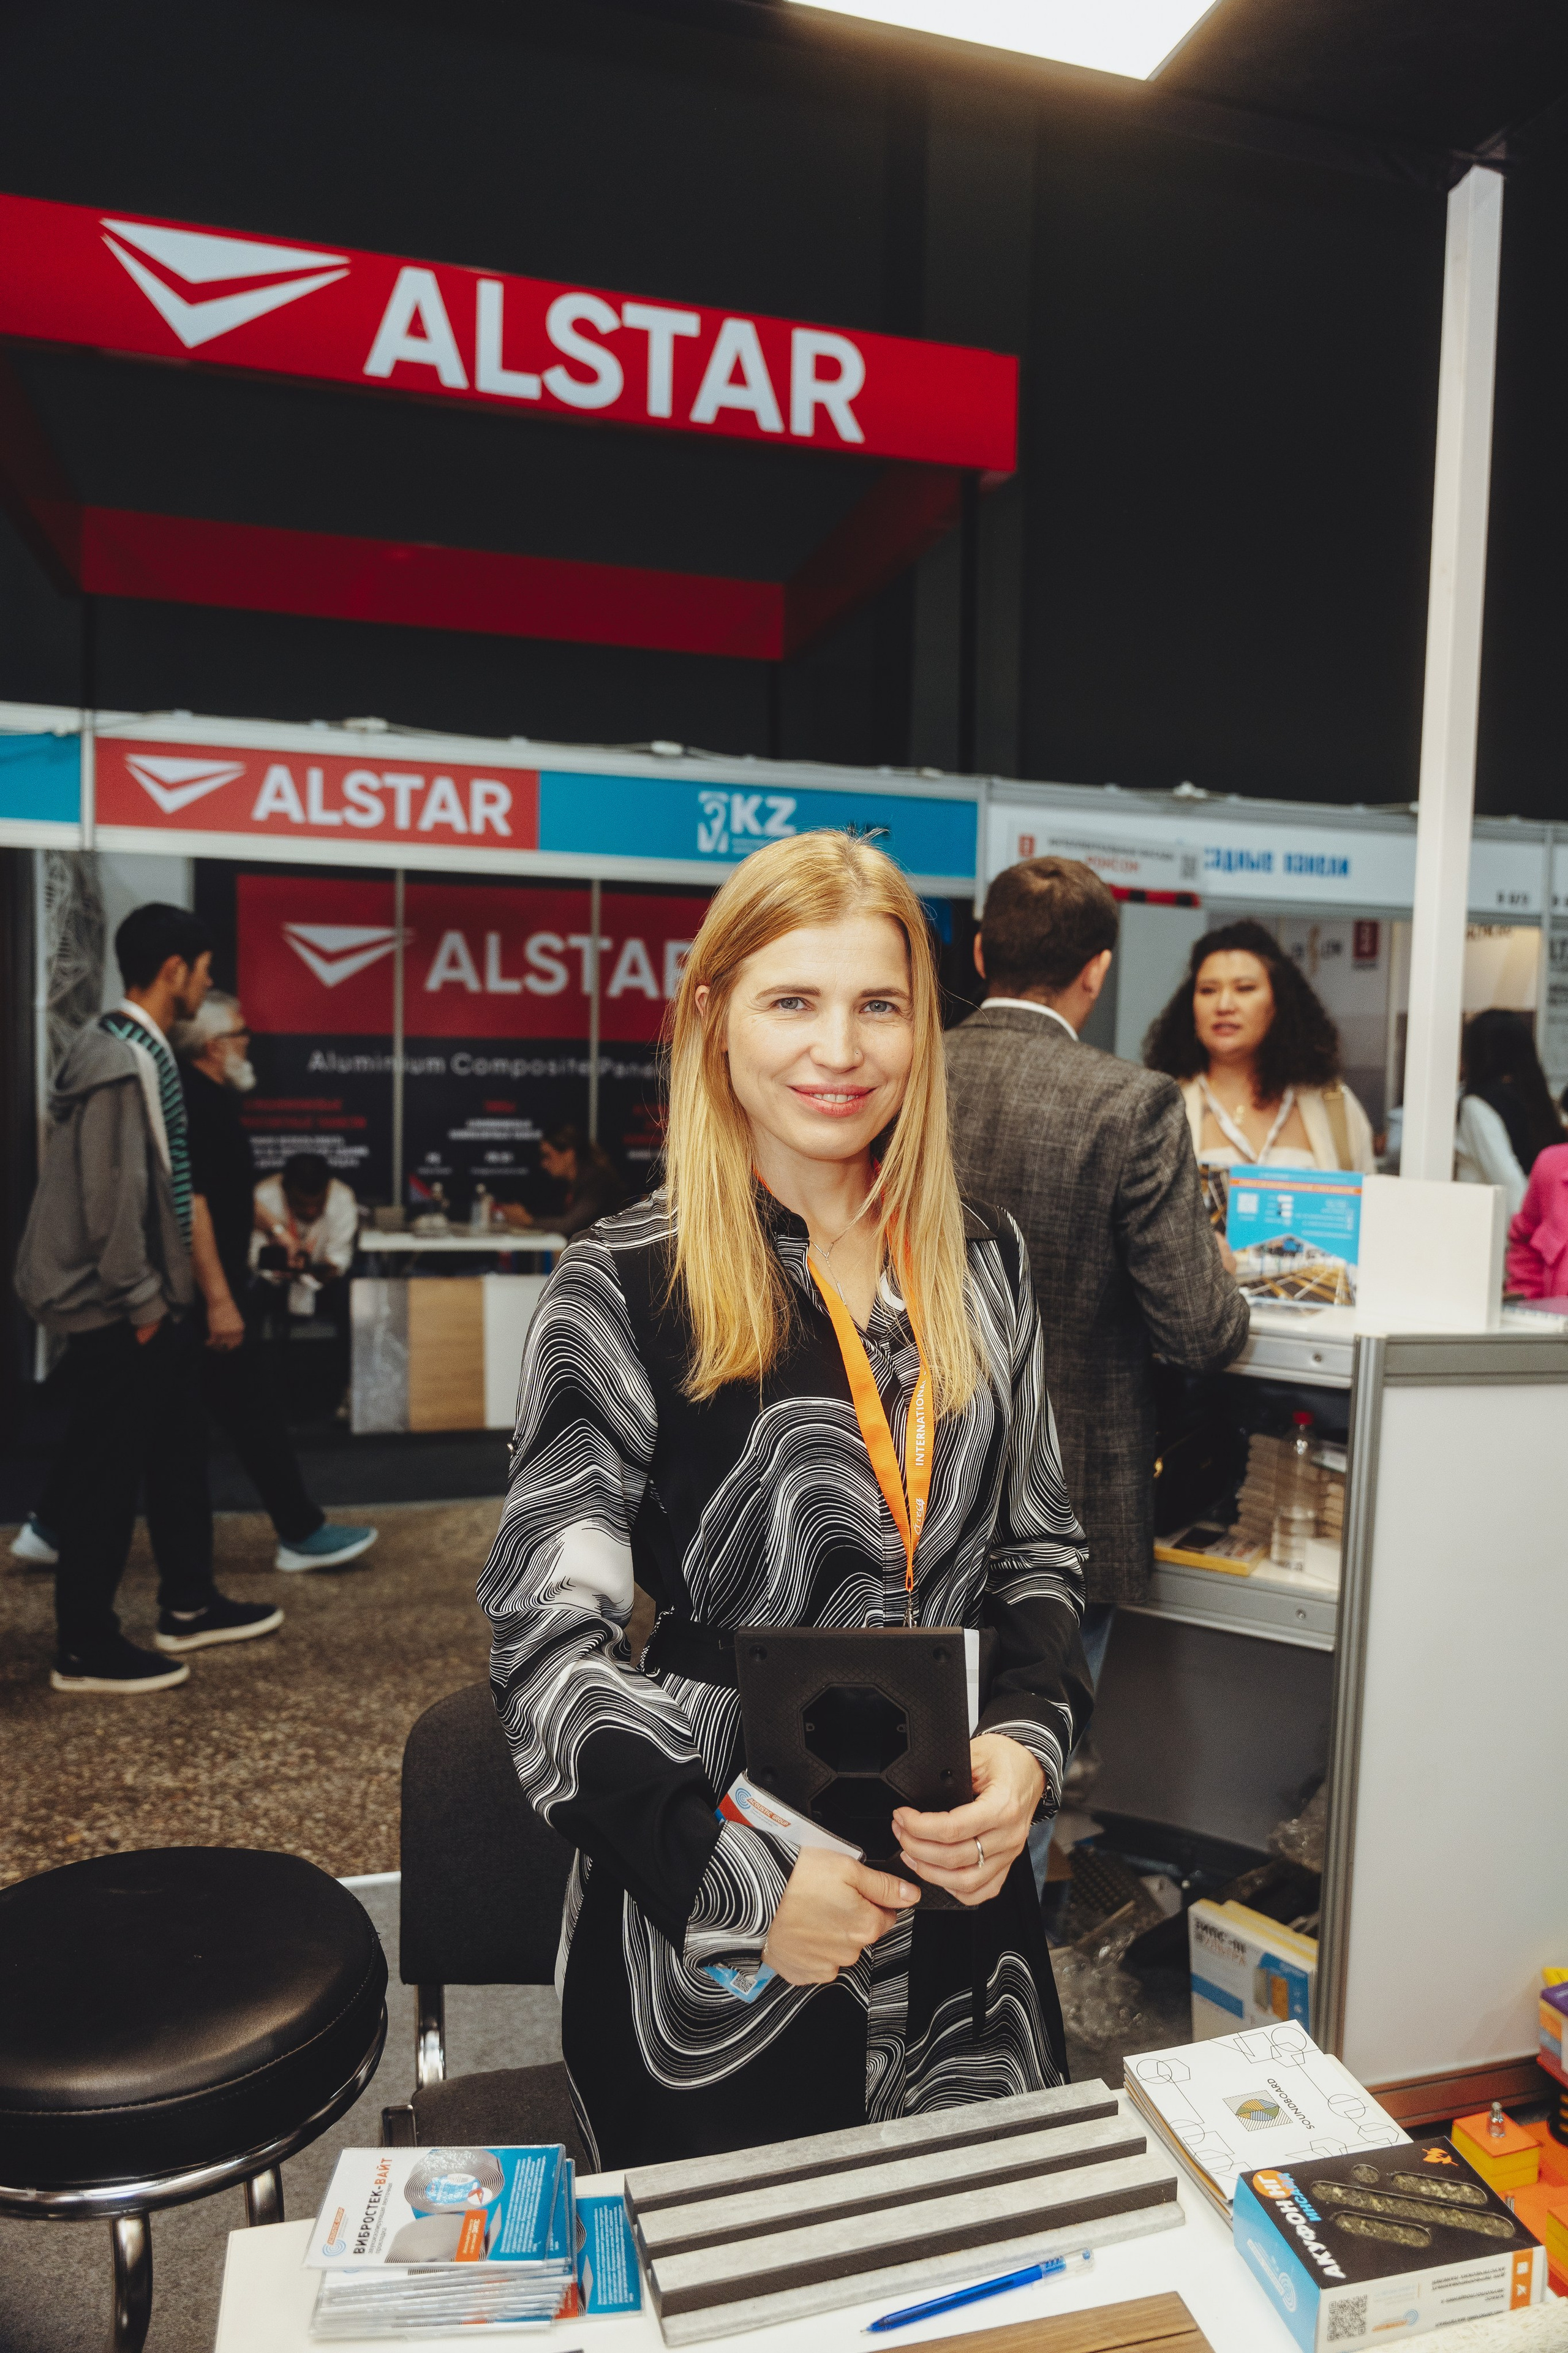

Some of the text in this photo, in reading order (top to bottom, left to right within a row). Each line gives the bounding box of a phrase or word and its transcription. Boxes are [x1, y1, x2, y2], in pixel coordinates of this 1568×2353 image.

[363, 265, 866, 444] ALSTAR
[251, 764, 513, 836] ALSTAR
[730, 793, 796, 837] KZ
[307, 1049, 447, 1076] Aluminum
[915, 1380, 927, 1466] INTERNATIONAL
[748, 1798, 772, 1818] ACOUSTIC
[772, 1814, 789, 1826] GROUP
[1267, 2078, 1315, 2130] SOUNDBOARD
[353, 2157, 393, 2254] ВИБРОСТЕК-ВАЙТ
[1275, 2200, 1347, 2279] АКУФОН
